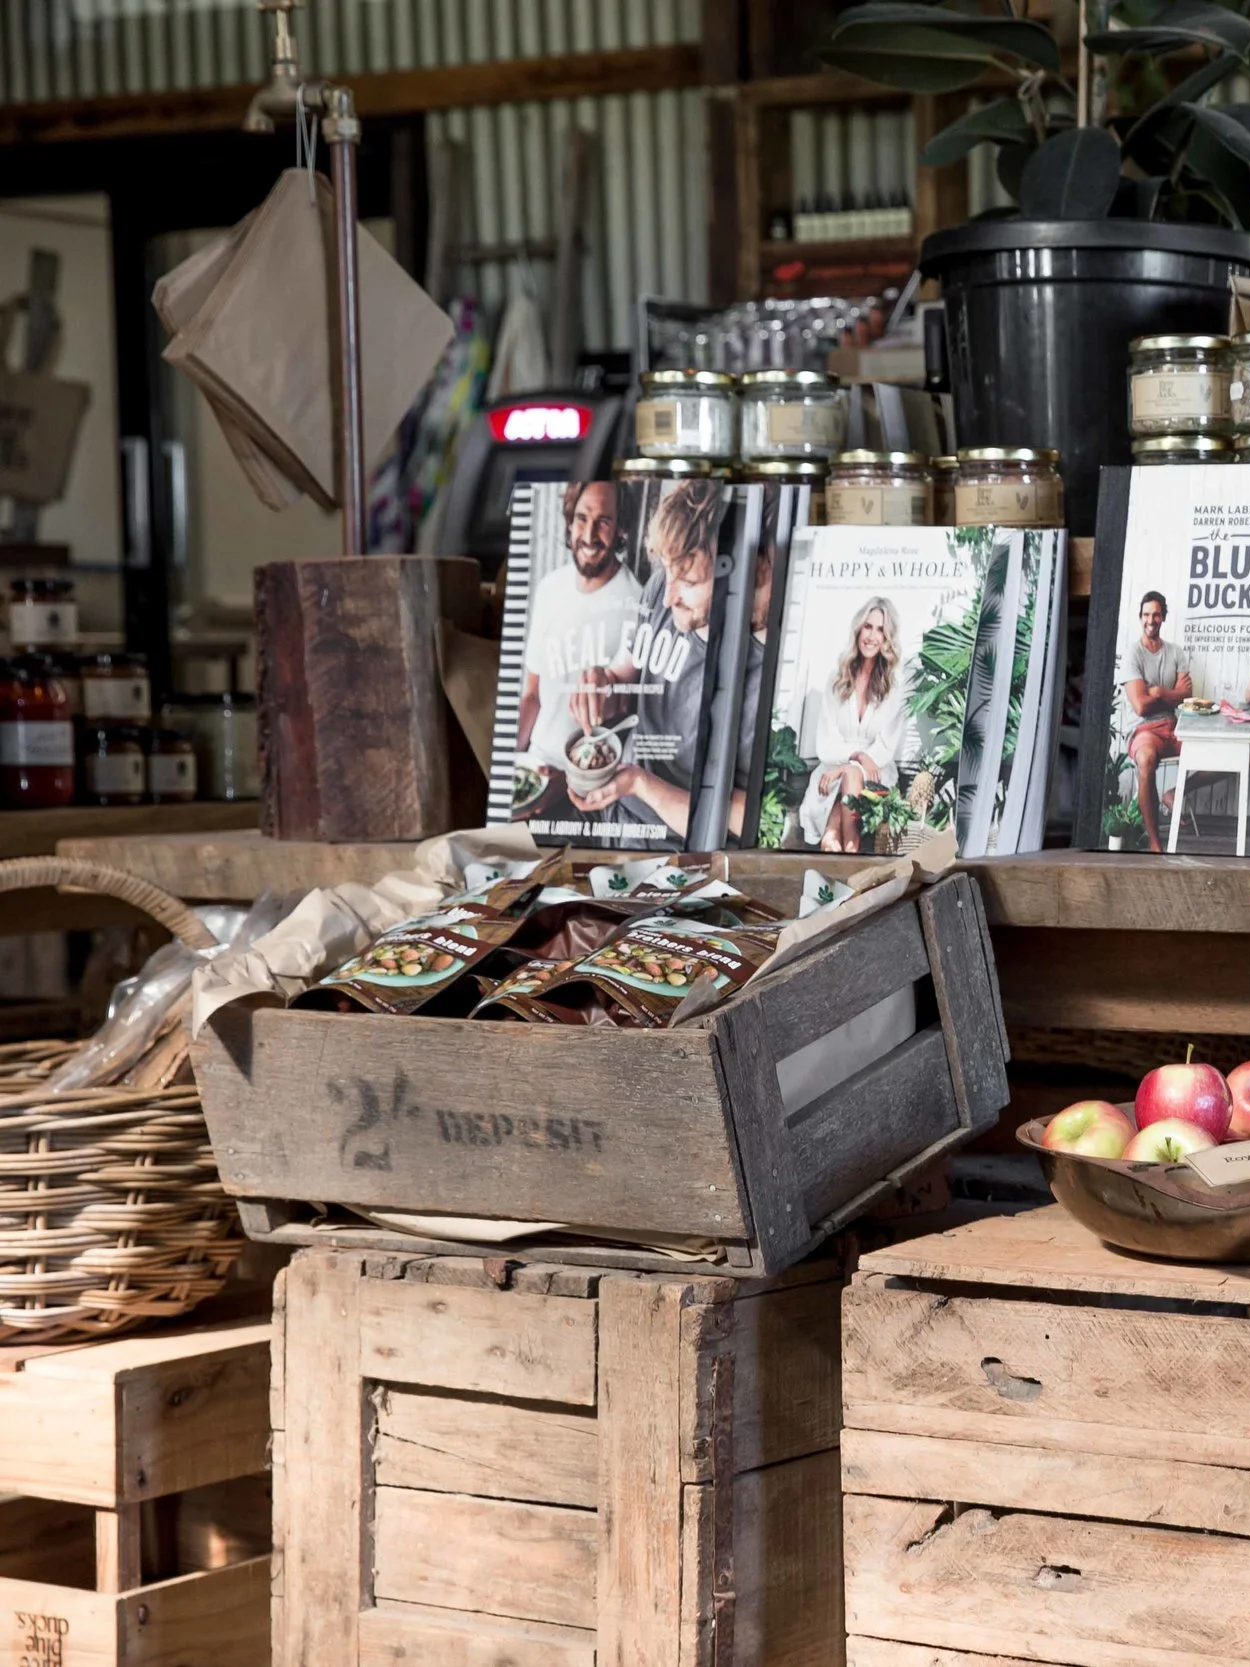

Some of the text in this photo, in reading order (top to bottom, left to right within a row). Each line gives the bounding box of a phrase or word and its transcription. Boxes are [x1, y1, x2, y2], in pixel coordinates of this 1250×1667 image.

[504, 408, 580, 440] ATM
[1194, 505, 1224, 514] MARK
[1193, 517, 1225, 526] DARREN
[1210, 528, 1229, 541] the
[810, 561, 964, 578] HAPPY & WHOLE
[1184, 624, 1236, 634] DELICIOUS
[546, 620, 691, 682] REAL FOOD
[529, 820, 667, 839] MARK LABROOY & DARREN ROBERTSON
[433, 936, 477, 956] blend
[696, 949, 742, 970] blend
